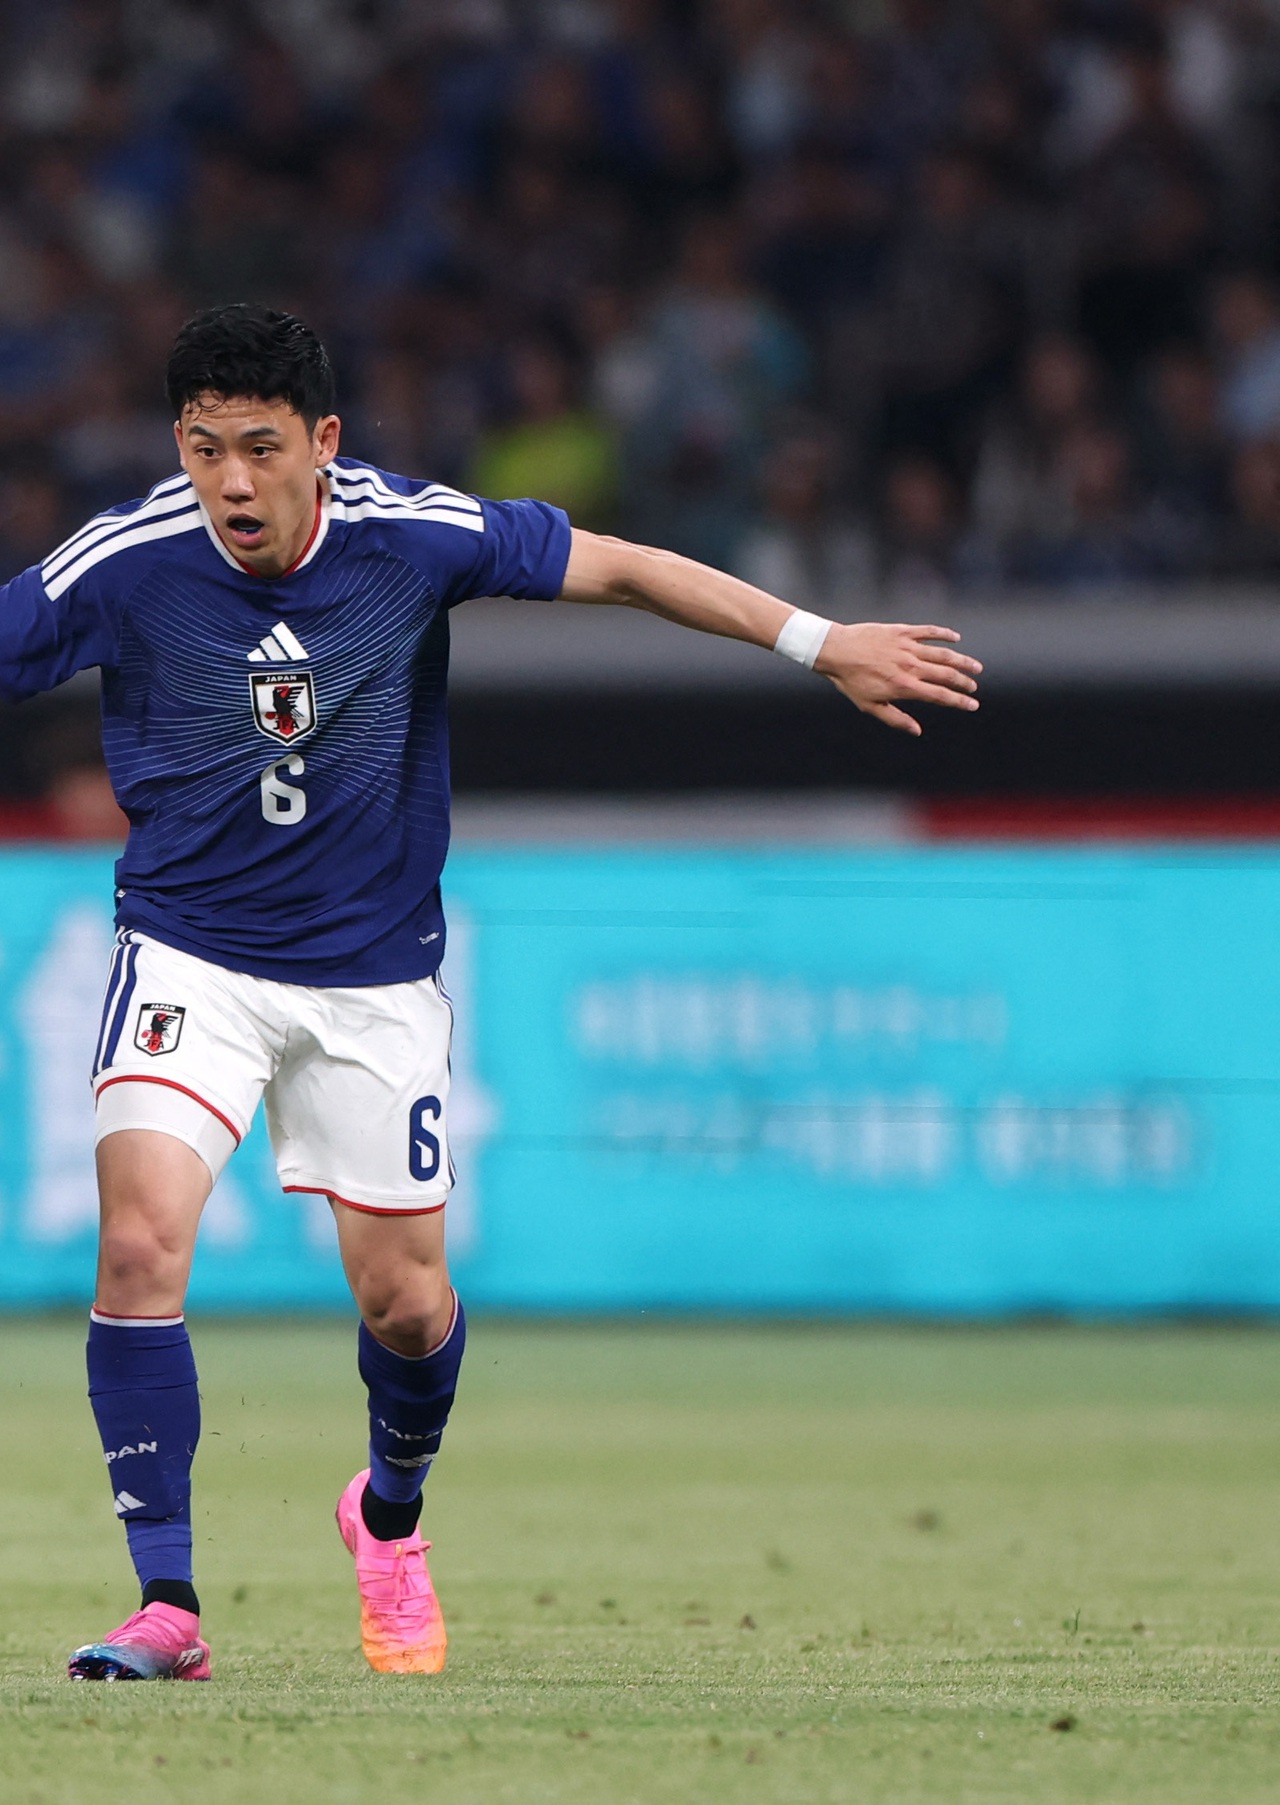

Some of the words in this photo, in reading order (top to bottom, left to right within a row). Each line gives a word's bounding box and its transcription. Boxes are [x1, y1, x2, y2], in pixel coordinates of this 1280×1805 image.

[264, 675, 298, 683] JAPAN
[272, 720, 301, 730] JFA
[260, 753, 307, 826] 6
[150, 1004, 176, 1012] JAPAN
[143, 1039, 165, 1050] JFA
[409, 1095, 442, 1181] 6
